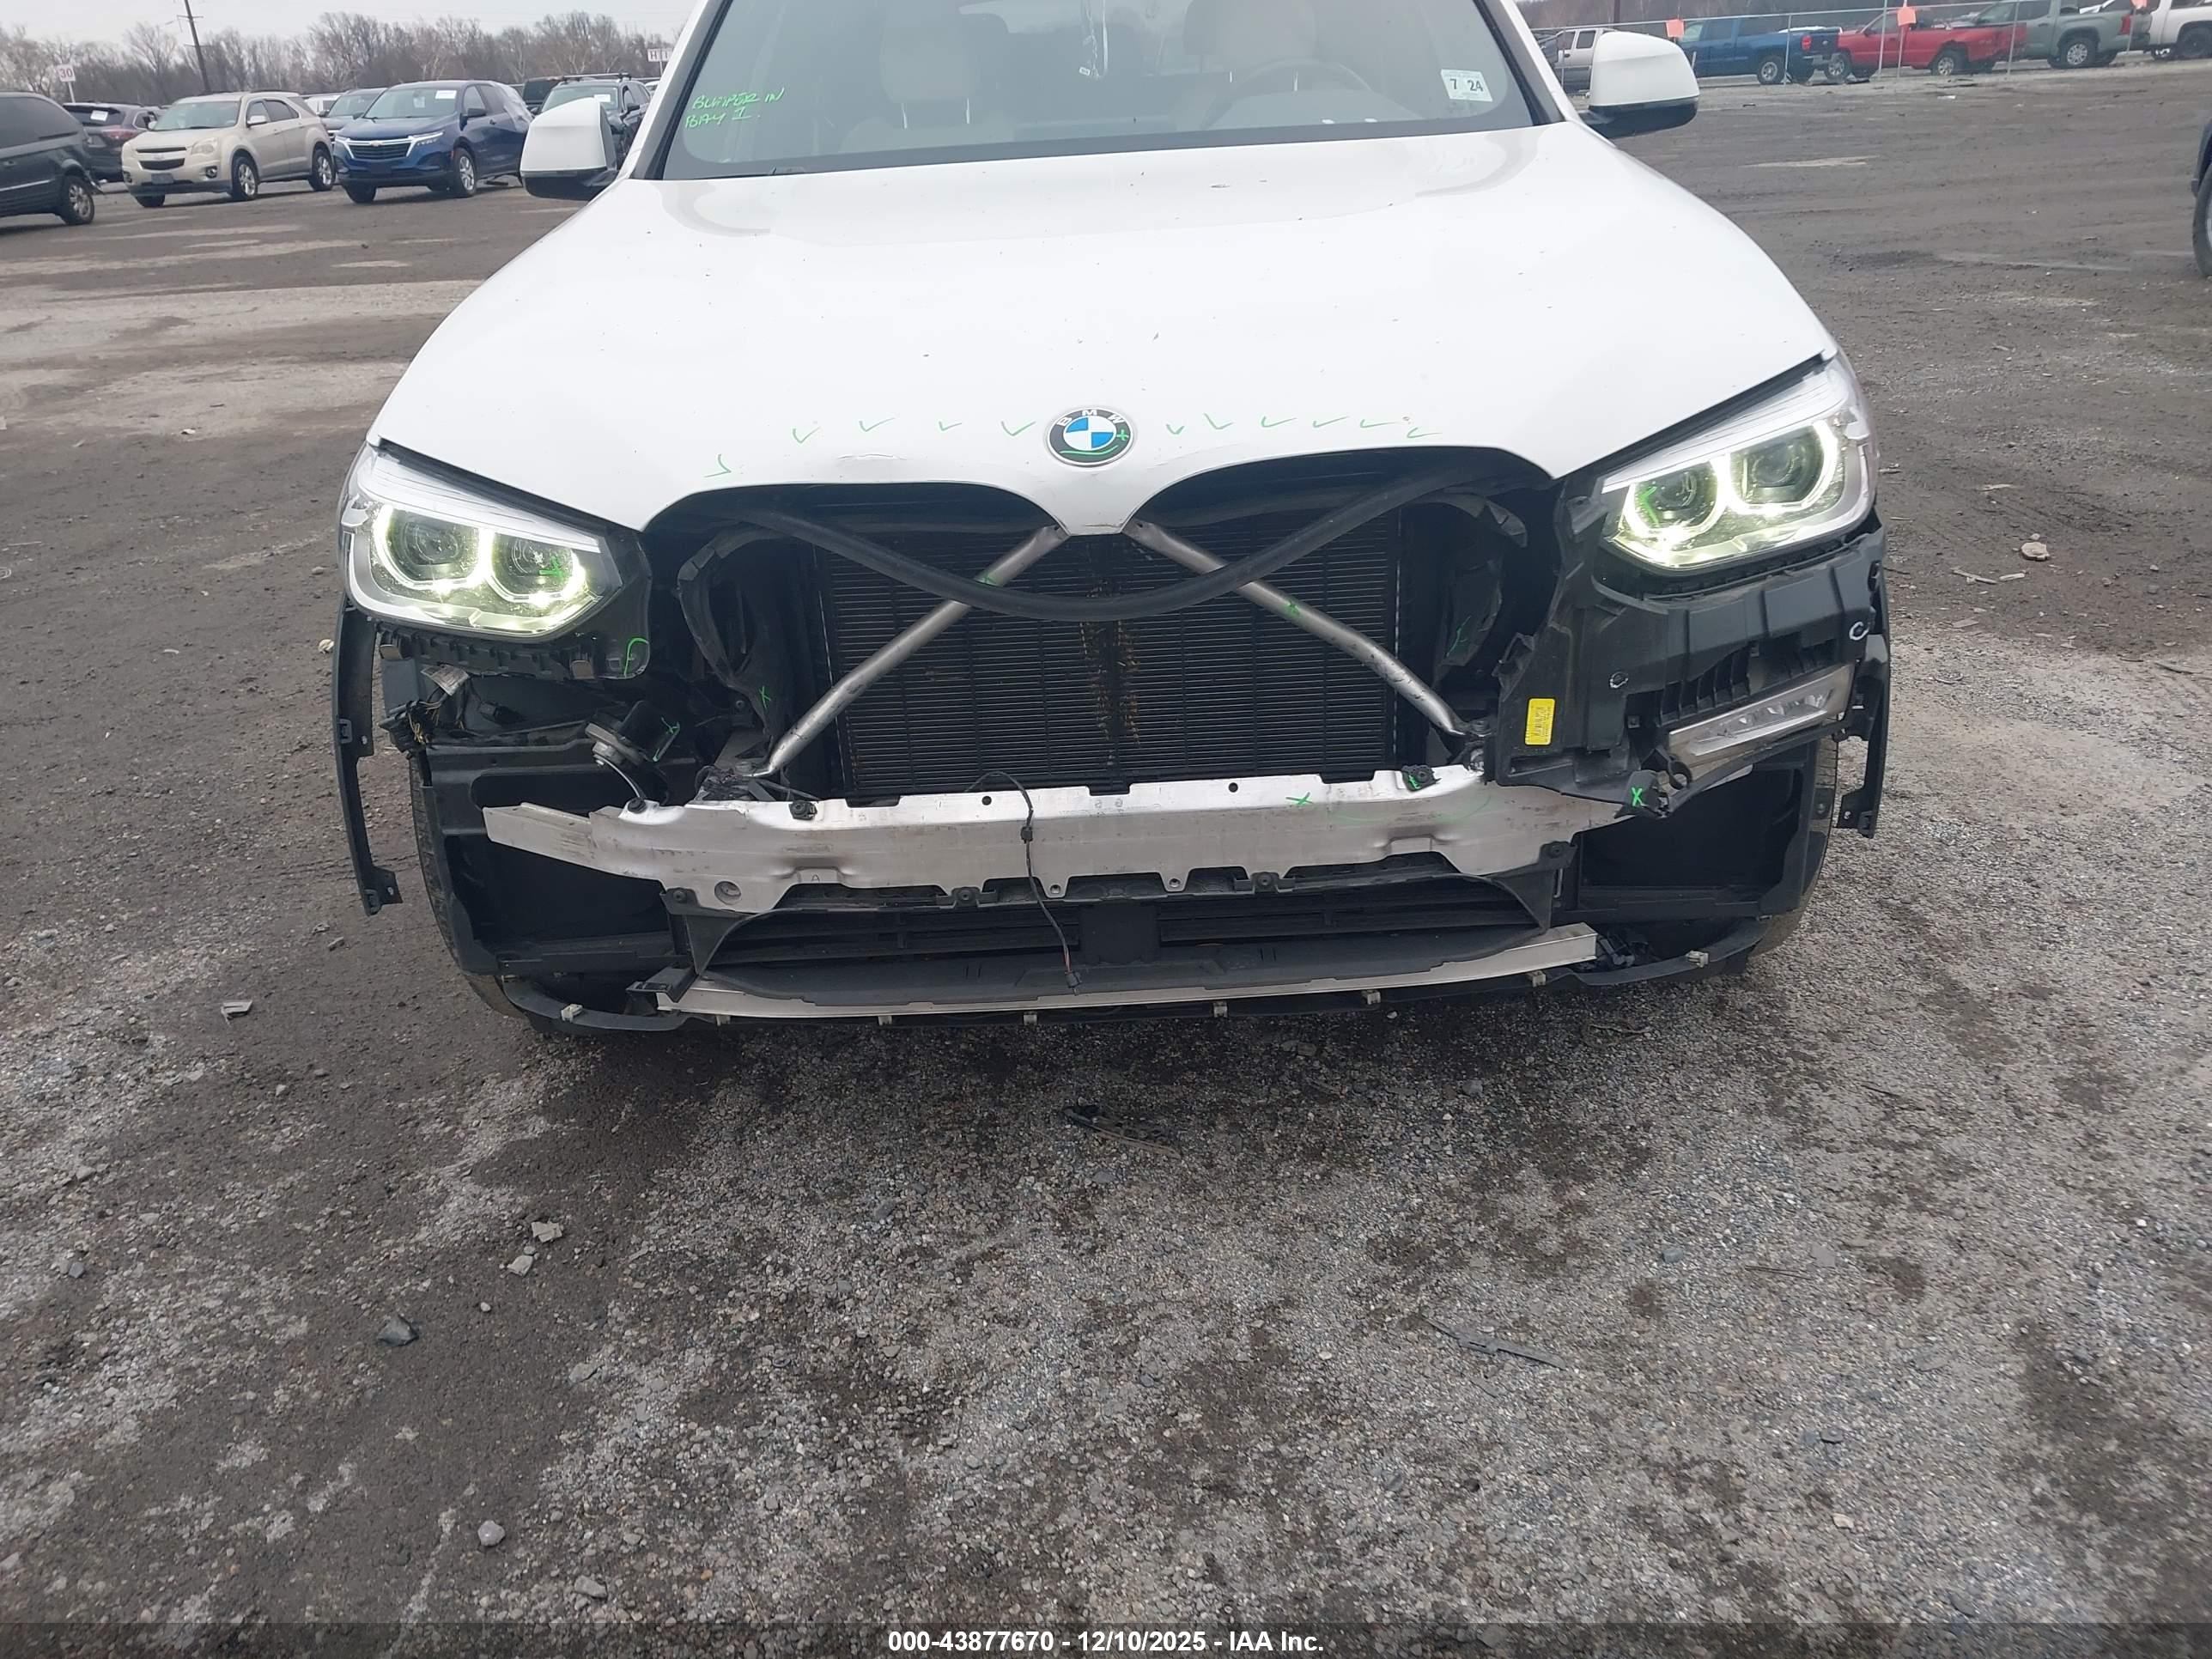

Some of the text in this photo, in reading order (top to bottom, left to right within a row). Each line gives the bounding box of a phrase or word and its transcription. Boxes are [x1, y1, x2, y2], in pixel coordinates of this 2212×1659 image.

[59, 68, 73, 79] 30
[1449, 78, 1484, 92] 7 24
[692, 87, 785, 110] BUMPER IN
[685, 112, 726, 129] BAY
[1057, 410, 1126, 427] BMW
